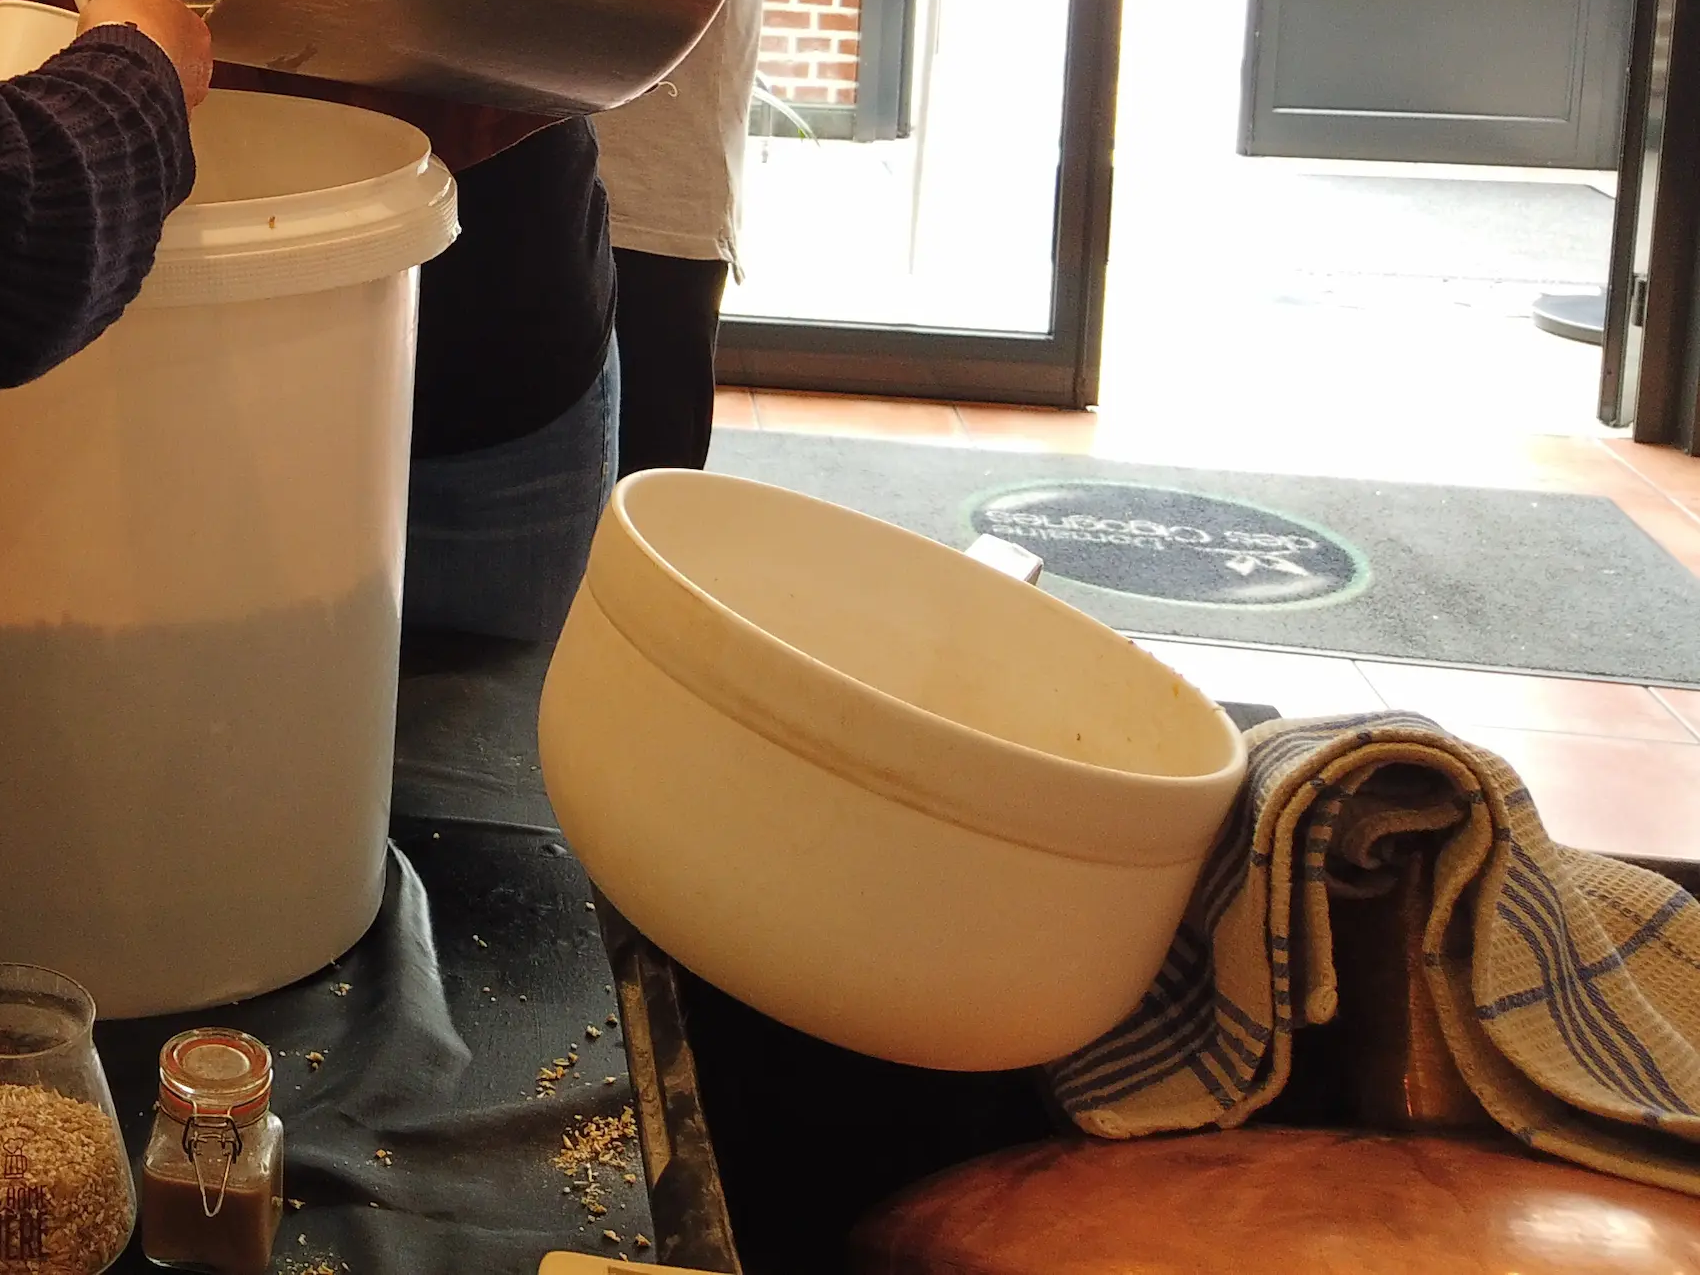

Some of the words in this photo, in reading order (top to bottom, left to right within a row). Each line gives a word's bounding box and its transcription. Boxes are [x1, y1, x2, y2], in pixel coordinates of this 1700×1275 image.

[985, 509, 1210, 546] Cigognes
[1224, 529, 1318, 552] des
[7, 1184, 48, 1211] HOME
